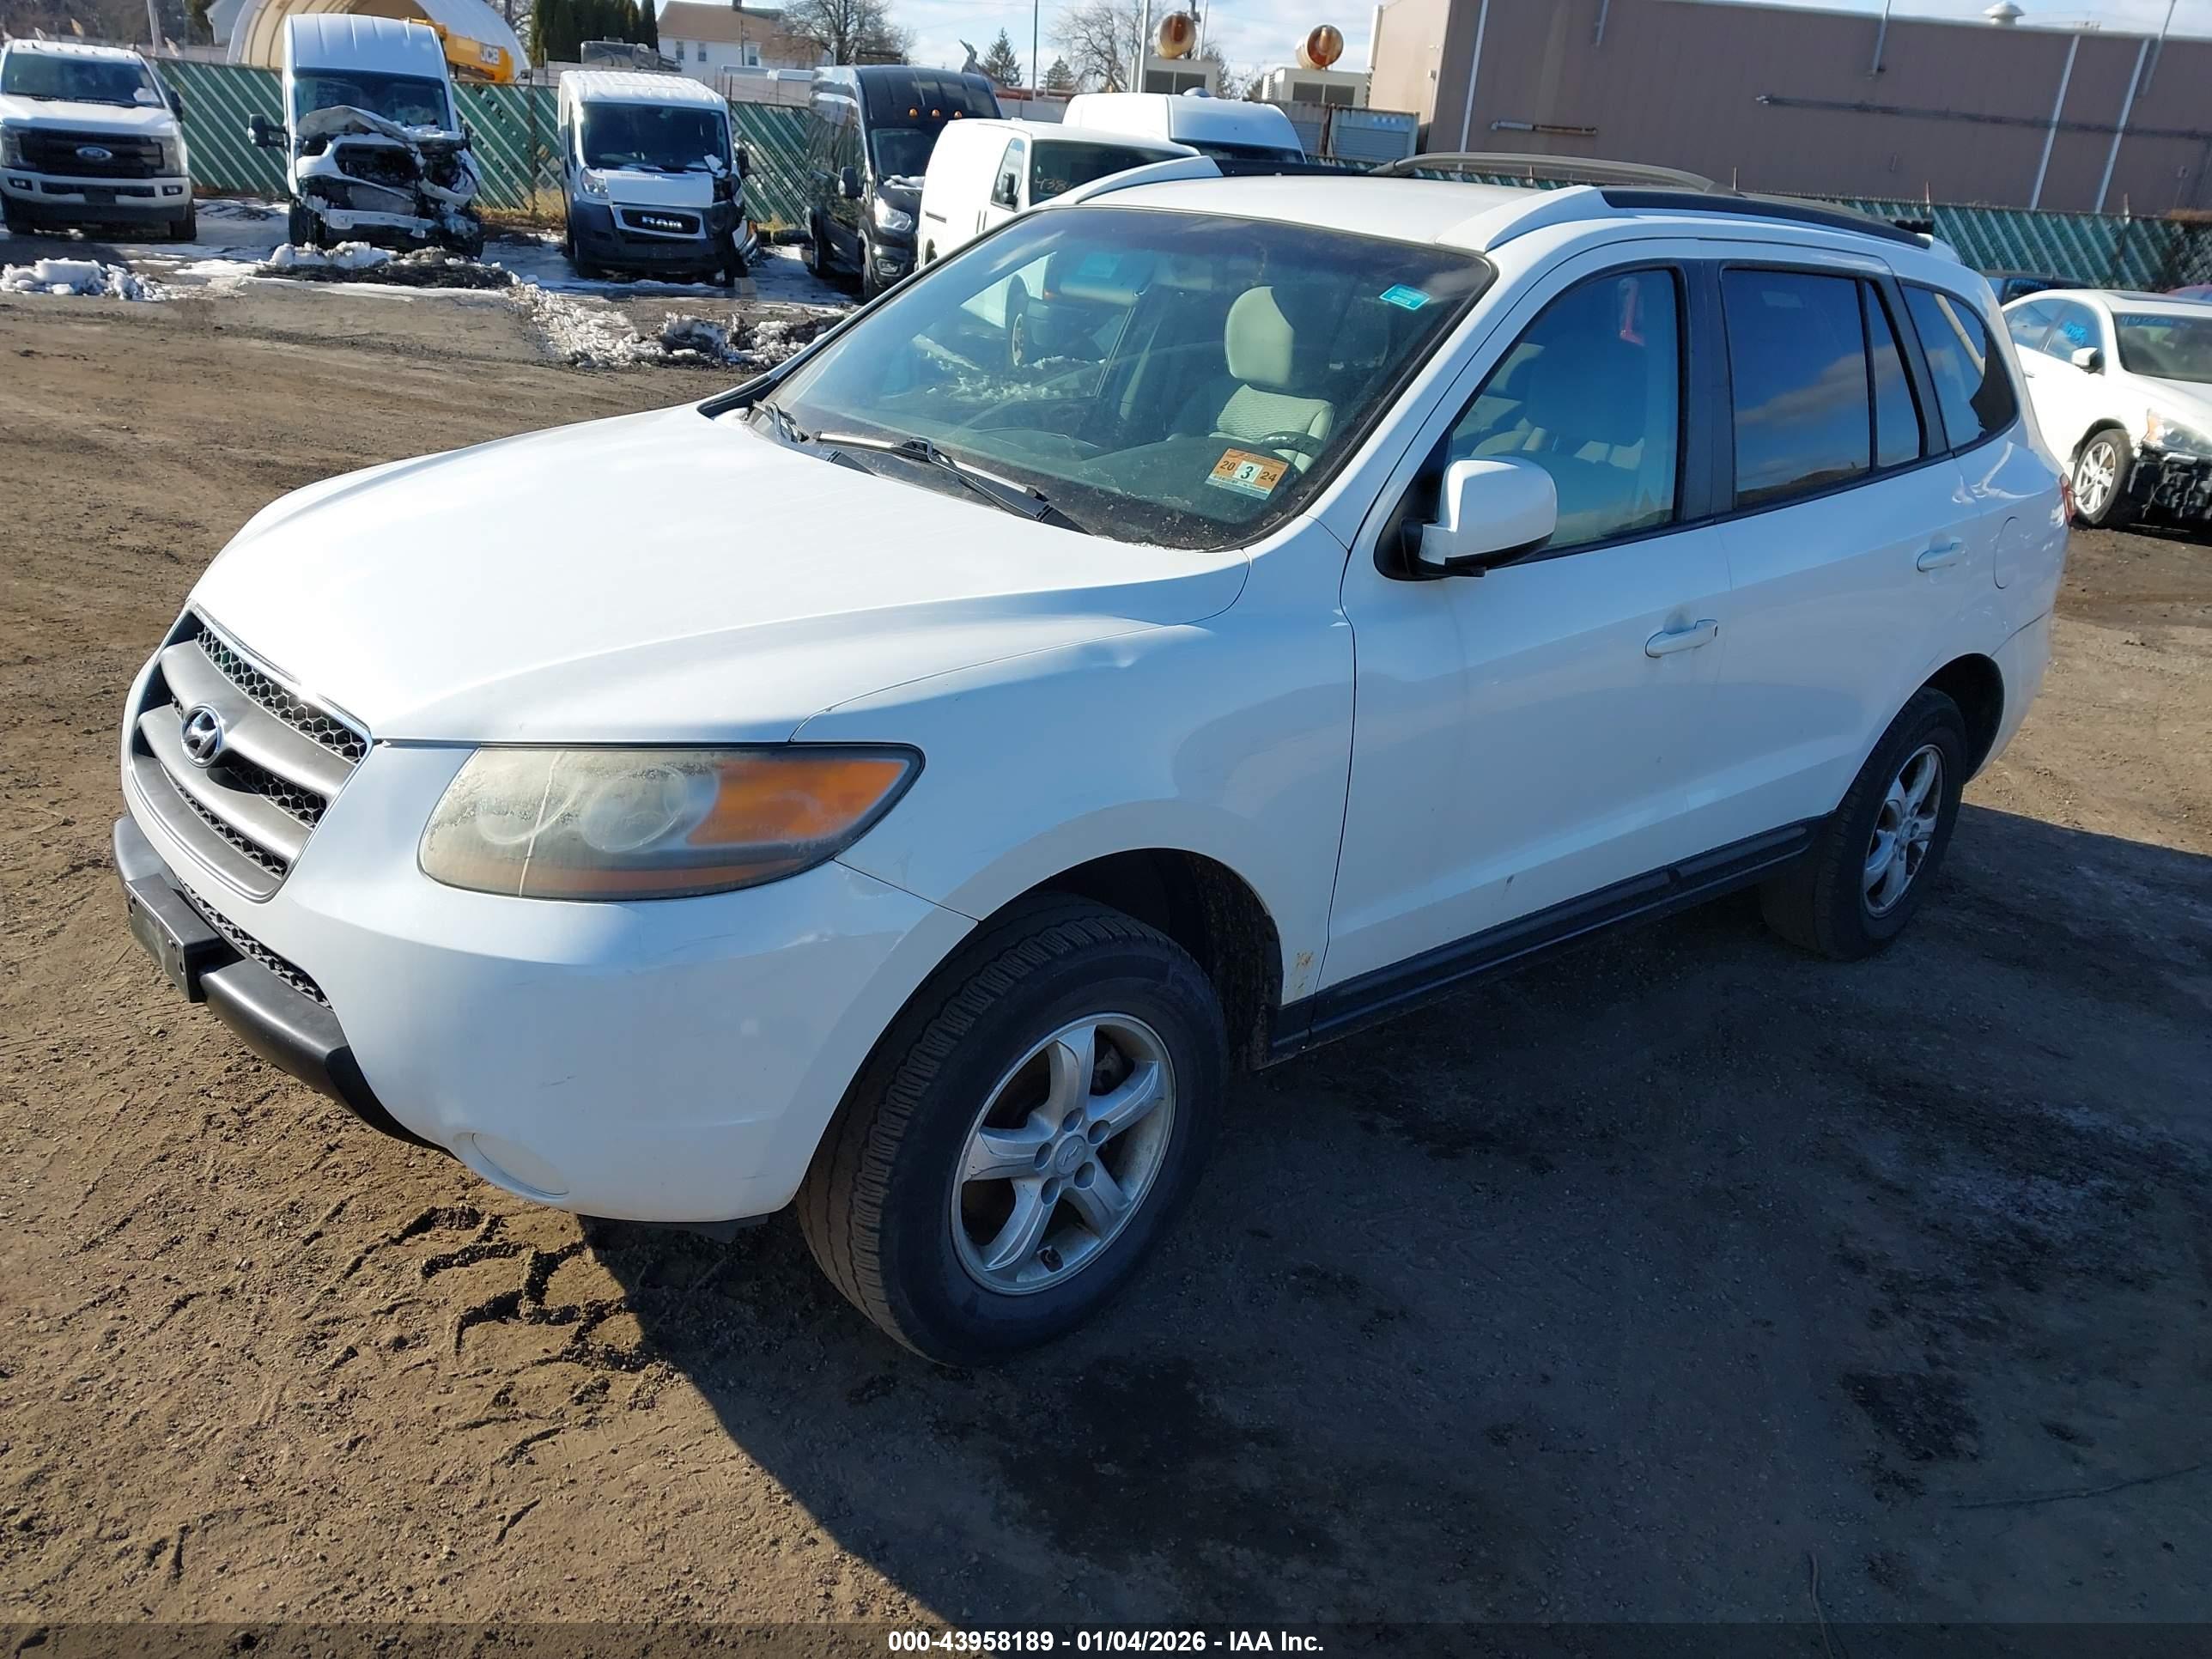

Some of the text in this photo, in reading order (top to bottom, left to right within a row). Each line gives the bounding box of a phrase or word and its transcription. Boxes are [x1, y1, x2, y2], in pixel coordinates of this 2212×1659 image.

[480, 46, 500, 64] JCB
[642, 216, 683, 228] RAM
[1219, 460, 1236, 471] 20
[1240, 465, 1254, 479] 3
[1260, 471, 1277, 483] 24
